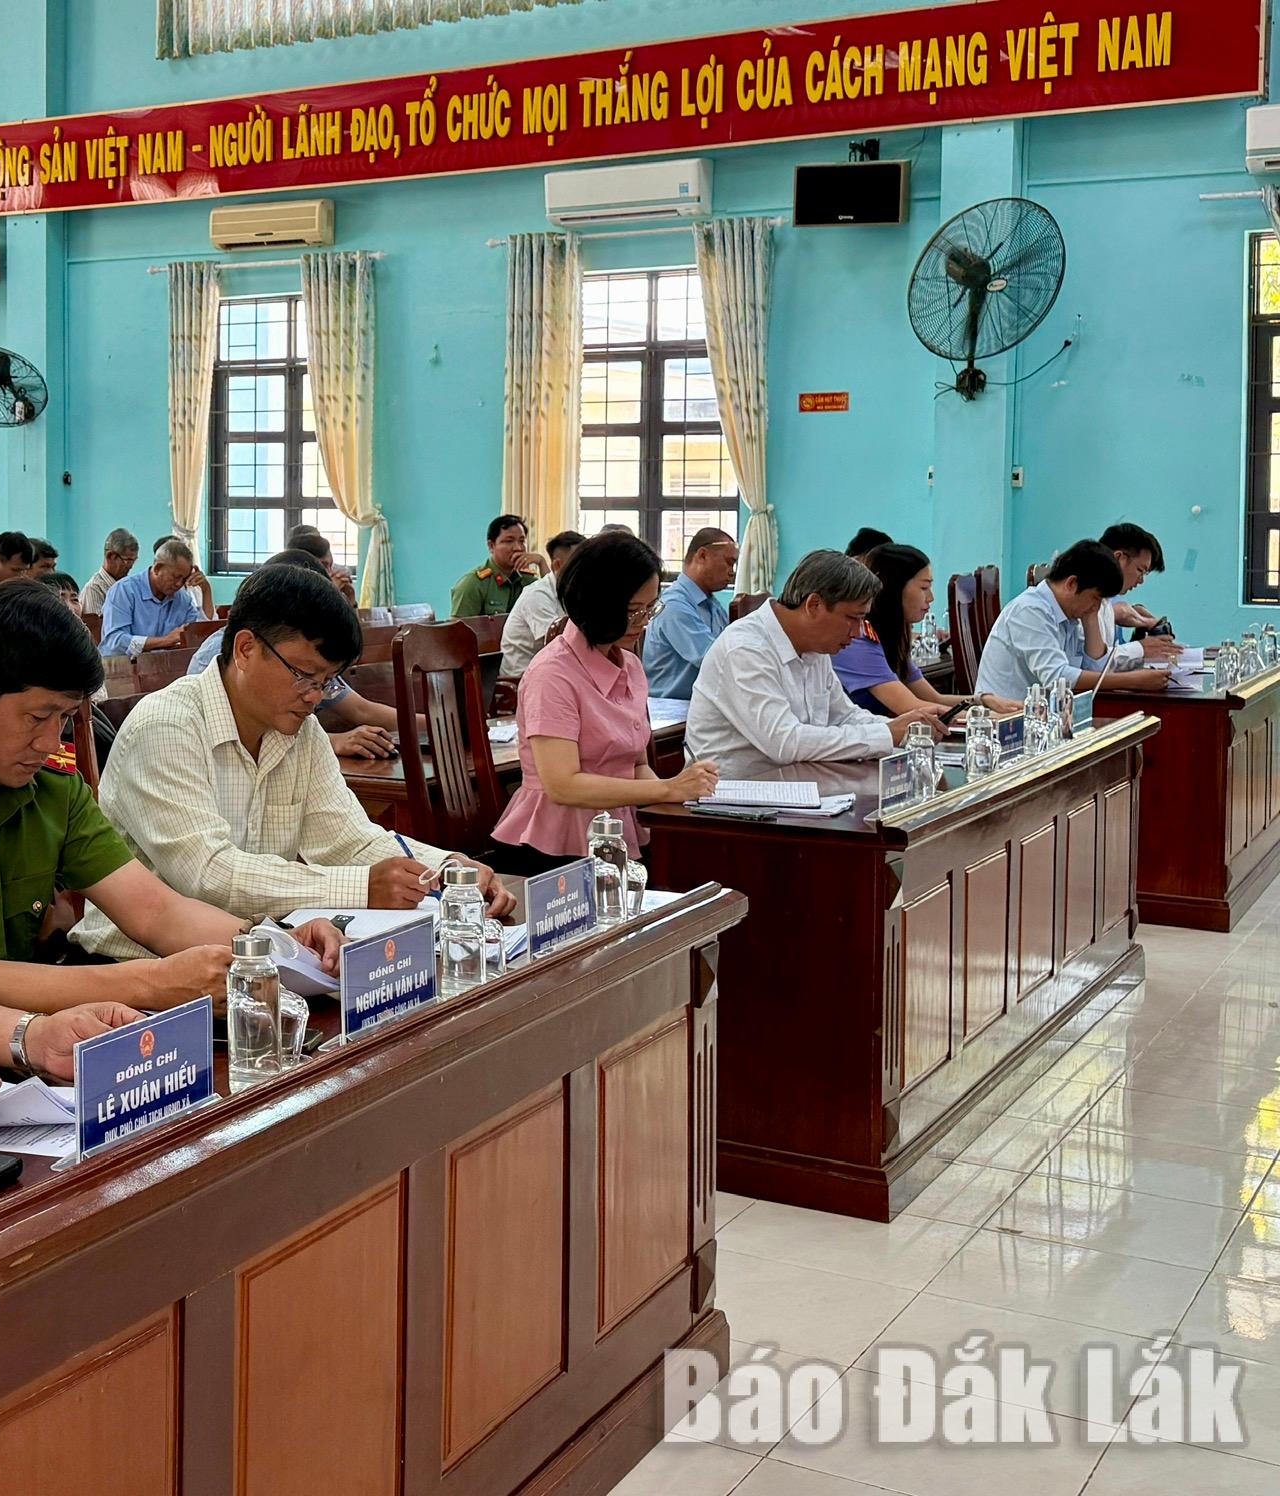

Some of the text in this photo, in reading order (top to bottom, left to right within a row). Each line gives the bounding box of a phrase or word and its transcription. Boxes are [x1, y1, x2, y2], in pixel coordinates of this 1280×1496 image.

[39, 126, 78, 185] SẢN
[85, 125, 129, 190] VIỆT
[138, 129, 184, 176] NAM
[209, 103, 274, 168] NGƯỜI
[282, 103, 342, 160] LÃNH
[349, 103, 401, 163] ĐẠO,
[405, 75, 438, 146] TỔ
[446, 74, 512, 143] CHỨC
[522, 83, 567, 147] MỌI
[578, 50, 669, 128] THẮNG
[680, 53, 724, 130] LỢI
[736, 37, 793, 112] CỦA
[805, 35, 884, 104] CÁCH
[897, 31, 988, 106] MẠNG
[1006, 11, 1079, 95] VIỆT
[1096, 10, 1172, 73] NAM
[395, 975, 413, 998] VĂN
[414, 969, 428, 991] LAI
[156, 1047, 178, 1067] CHÍ
[97, 1060, 197, 1124] LÊ XUÂN HIẾU
